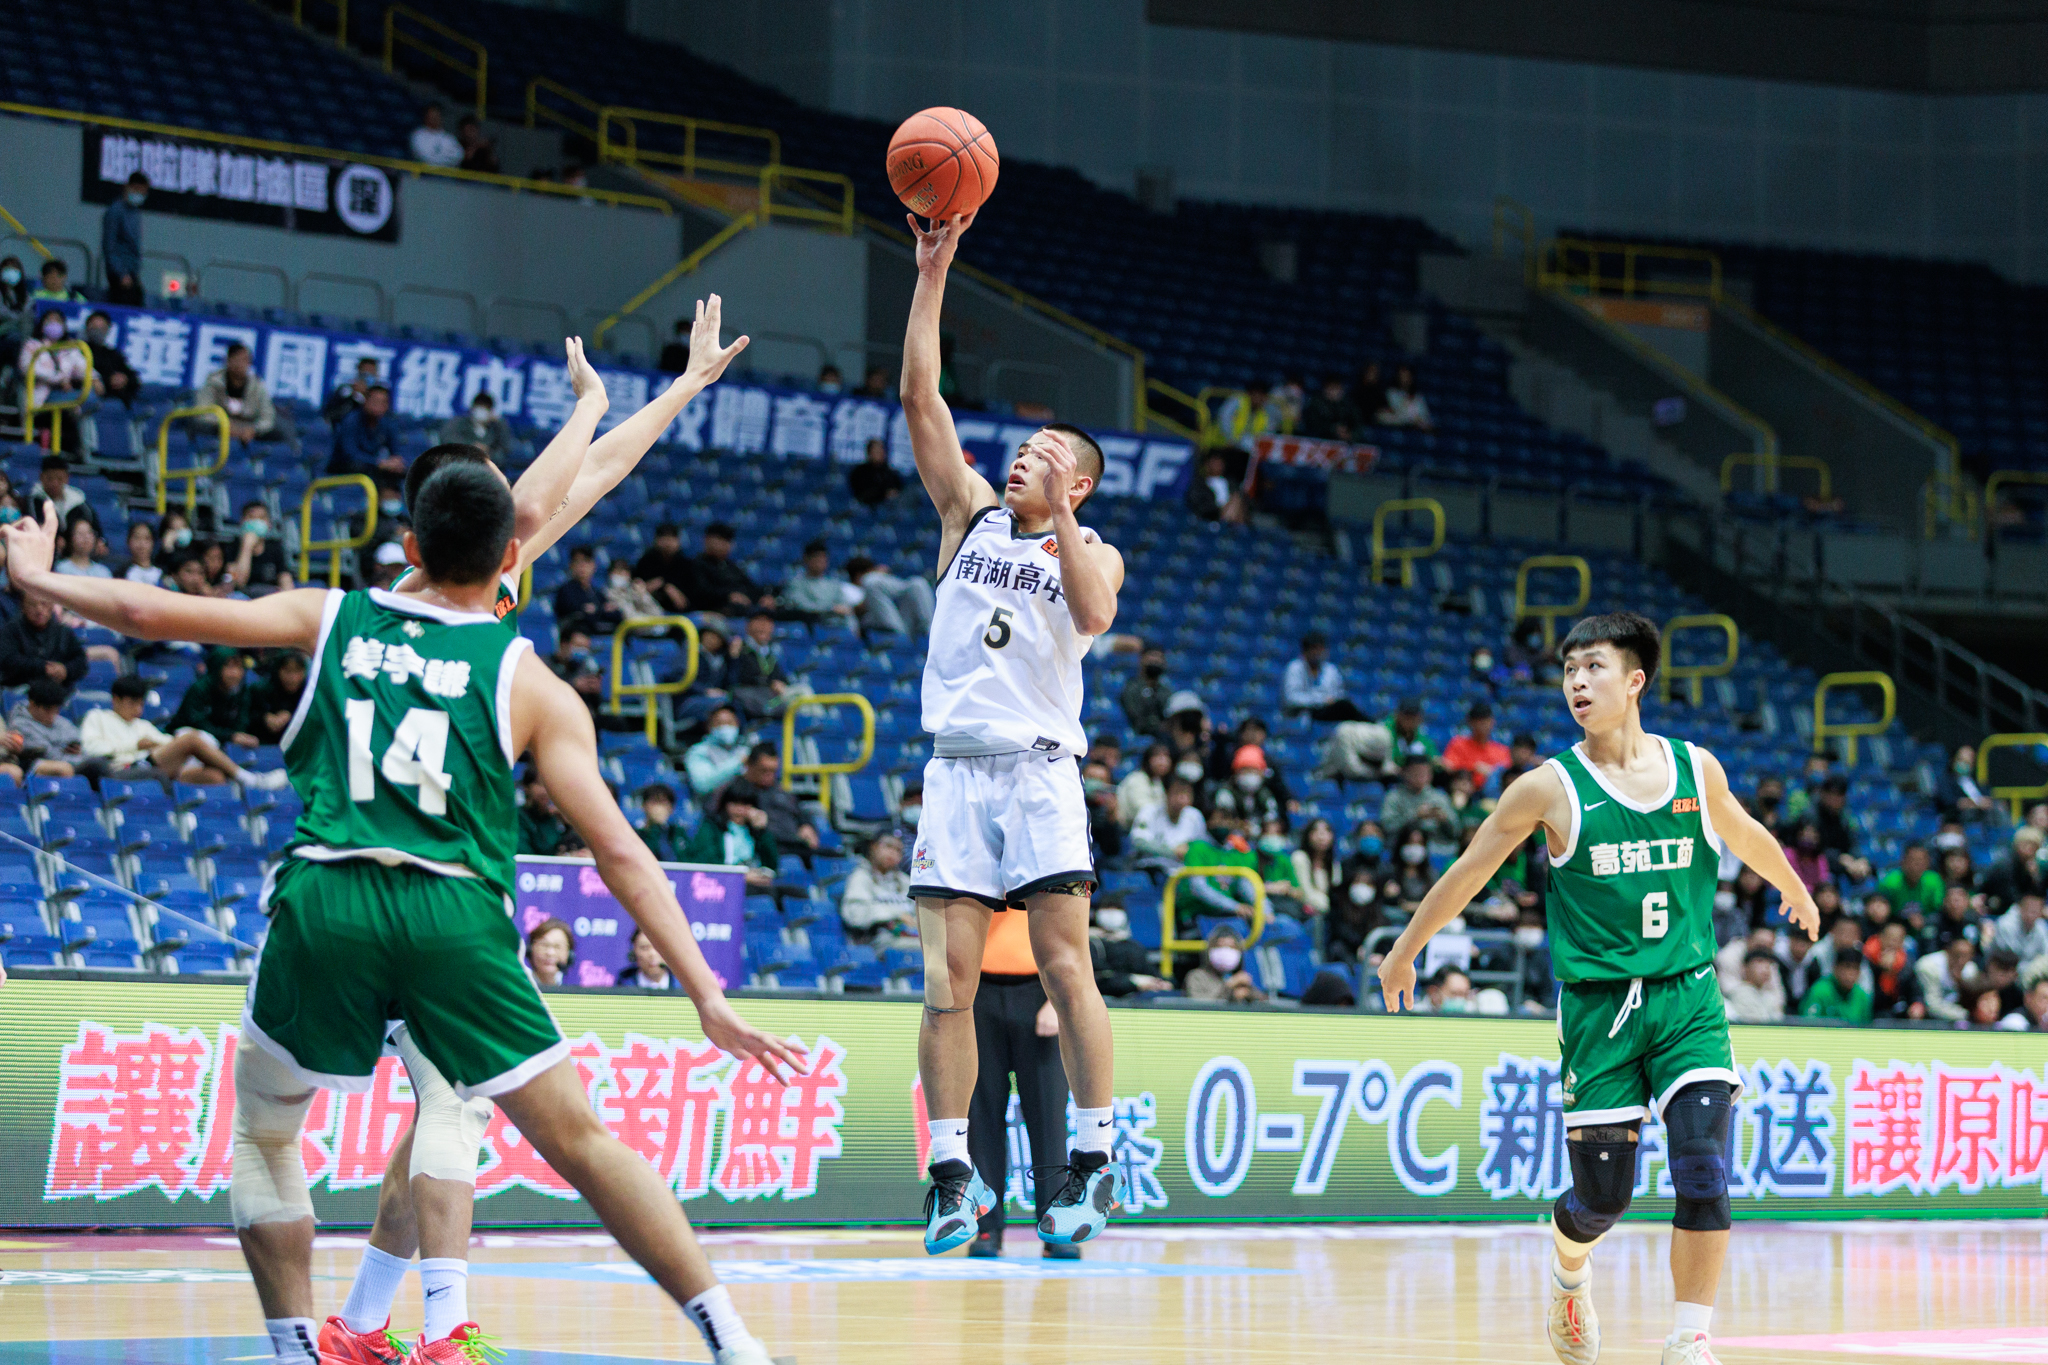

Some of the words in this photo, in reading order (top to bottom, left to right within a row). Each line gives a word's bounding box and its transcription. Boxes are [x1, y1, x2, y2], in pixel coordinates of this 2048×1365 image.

[984, 606, 1014, 650] 5
[345, 698, 452, 816] 14
[1589, 837, 1694, 876] 高苑工商
[1642, 891, 1669, 938] 6
